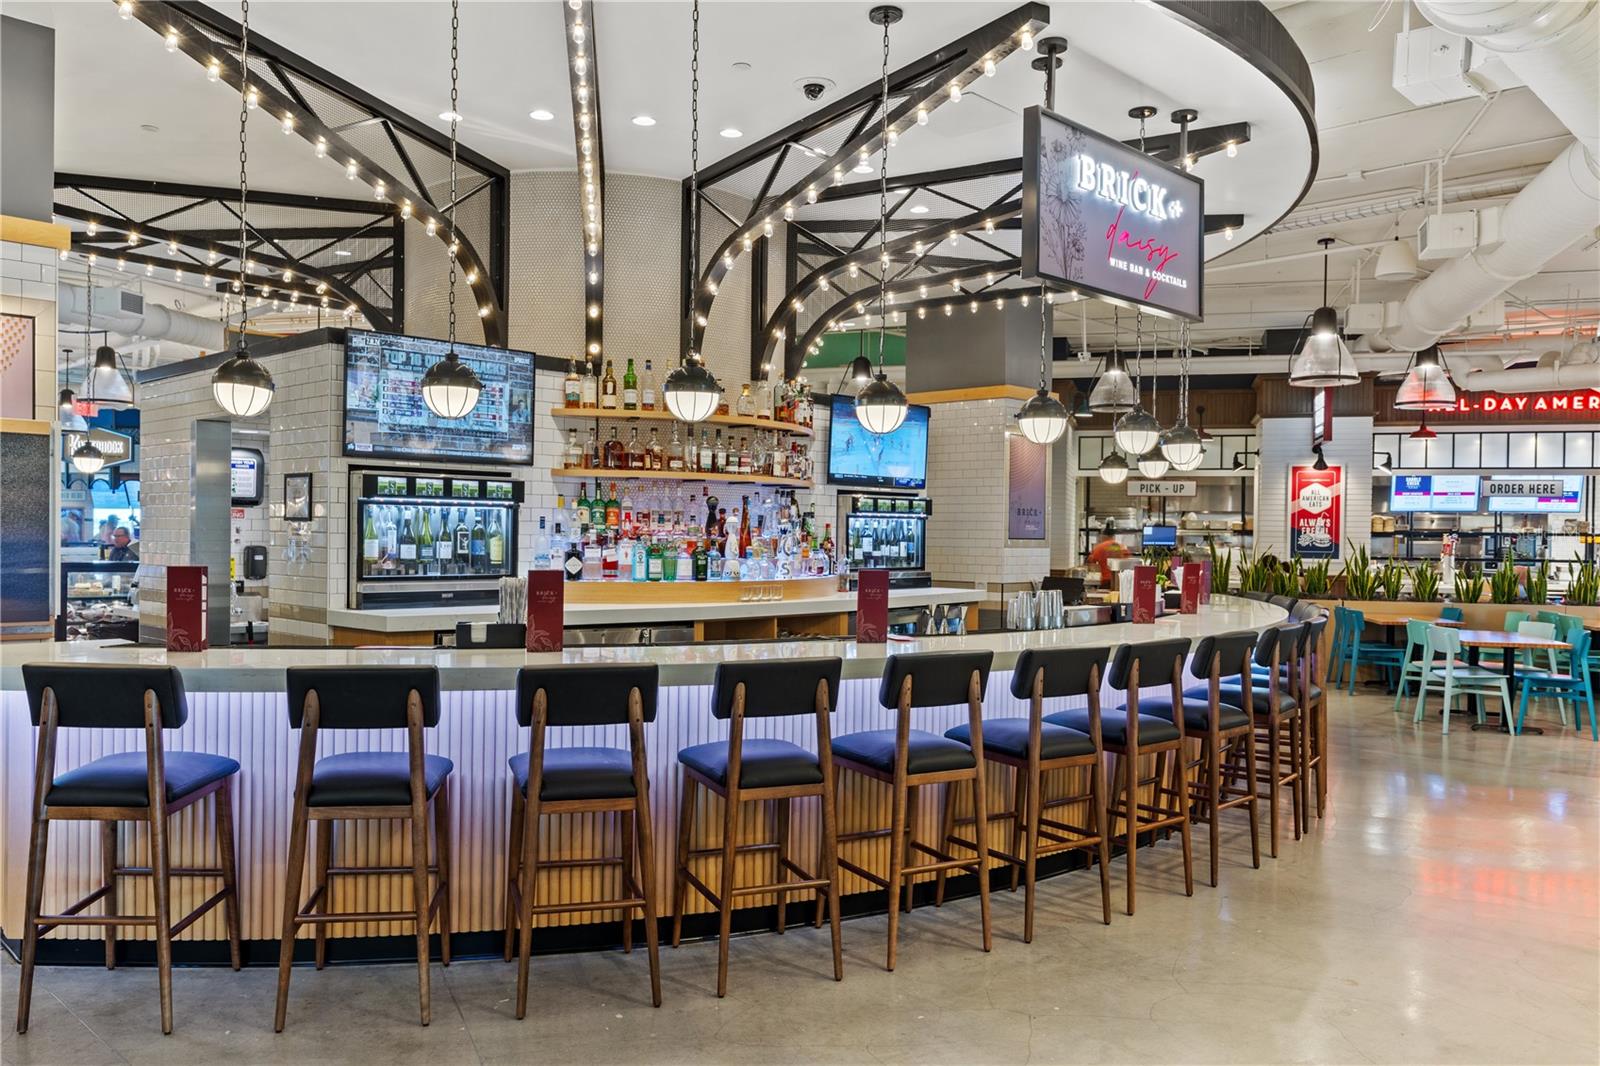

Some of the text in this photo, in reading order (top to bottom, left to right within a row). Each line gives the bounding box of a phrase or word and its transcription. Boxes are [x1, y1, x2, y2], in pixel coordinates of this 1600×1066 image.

[1077, 154, 1168, 221] BRICK
[1106, 204, 1178, 299] daisy
[1109, 257, 1188, 289] WINE BAR & COCKTAILS
[1428, 397, 1529, 412] L-DAY
[1140, 484, 1160, 493] PICK
[1172, 484, 1185, 493] UP
[1490, 483, 1524, 494] ORDER
[1528, 483, 1556, 494] HERE
[1299, 518, 1331, 527] ALWS
[1301, 527, 1329, 535] FRE
